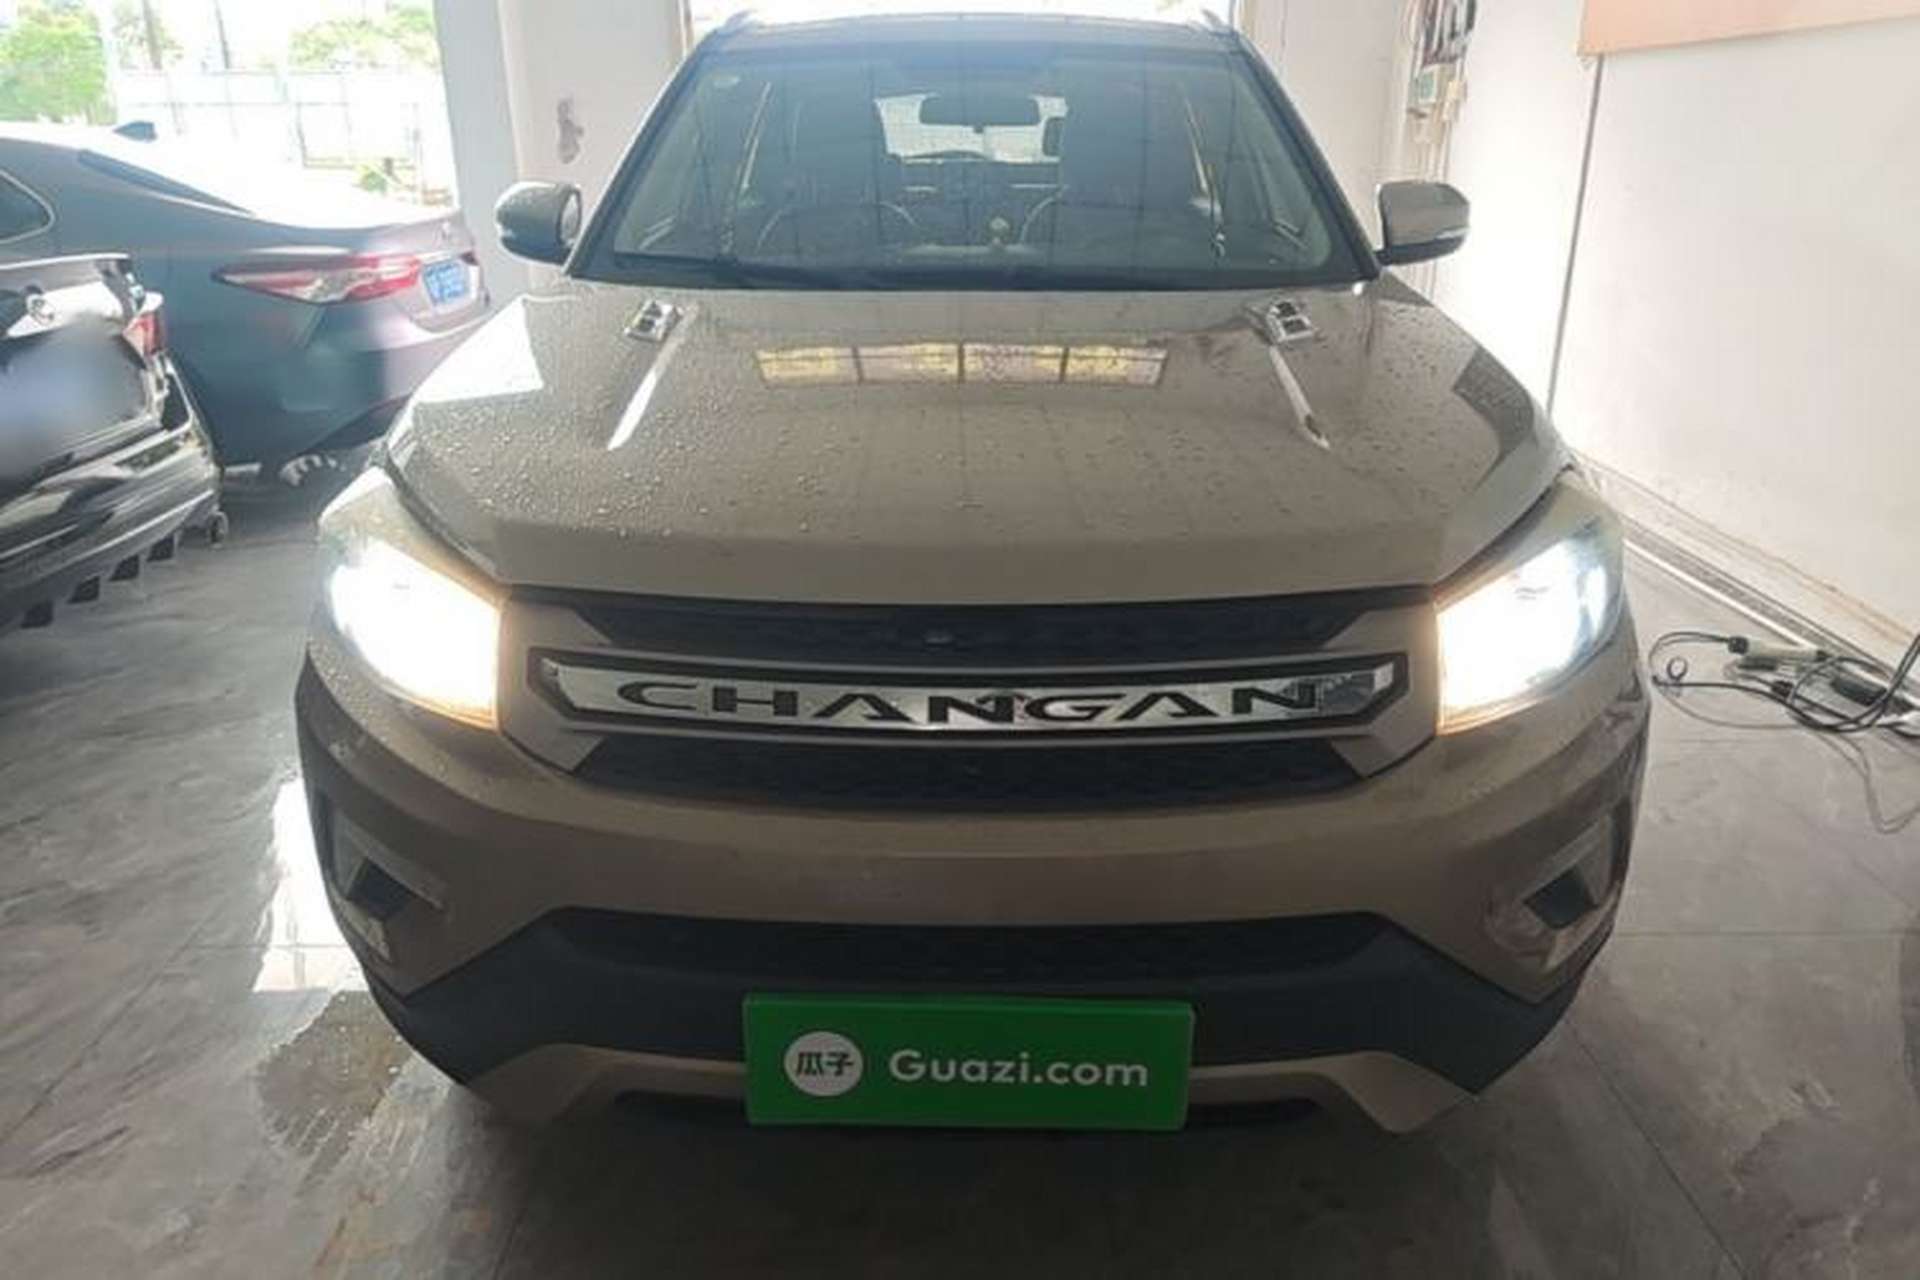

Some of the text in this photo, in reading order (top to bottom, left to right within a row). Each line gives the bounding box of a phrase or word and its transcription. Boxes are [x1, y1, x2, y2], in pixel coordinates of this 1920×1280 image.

[616, 682, 1319, 723] CHANGAN
[796, 1051, 854, 1077] 瓜子
[889, 1049, 1148, 1087] Guazi.com
